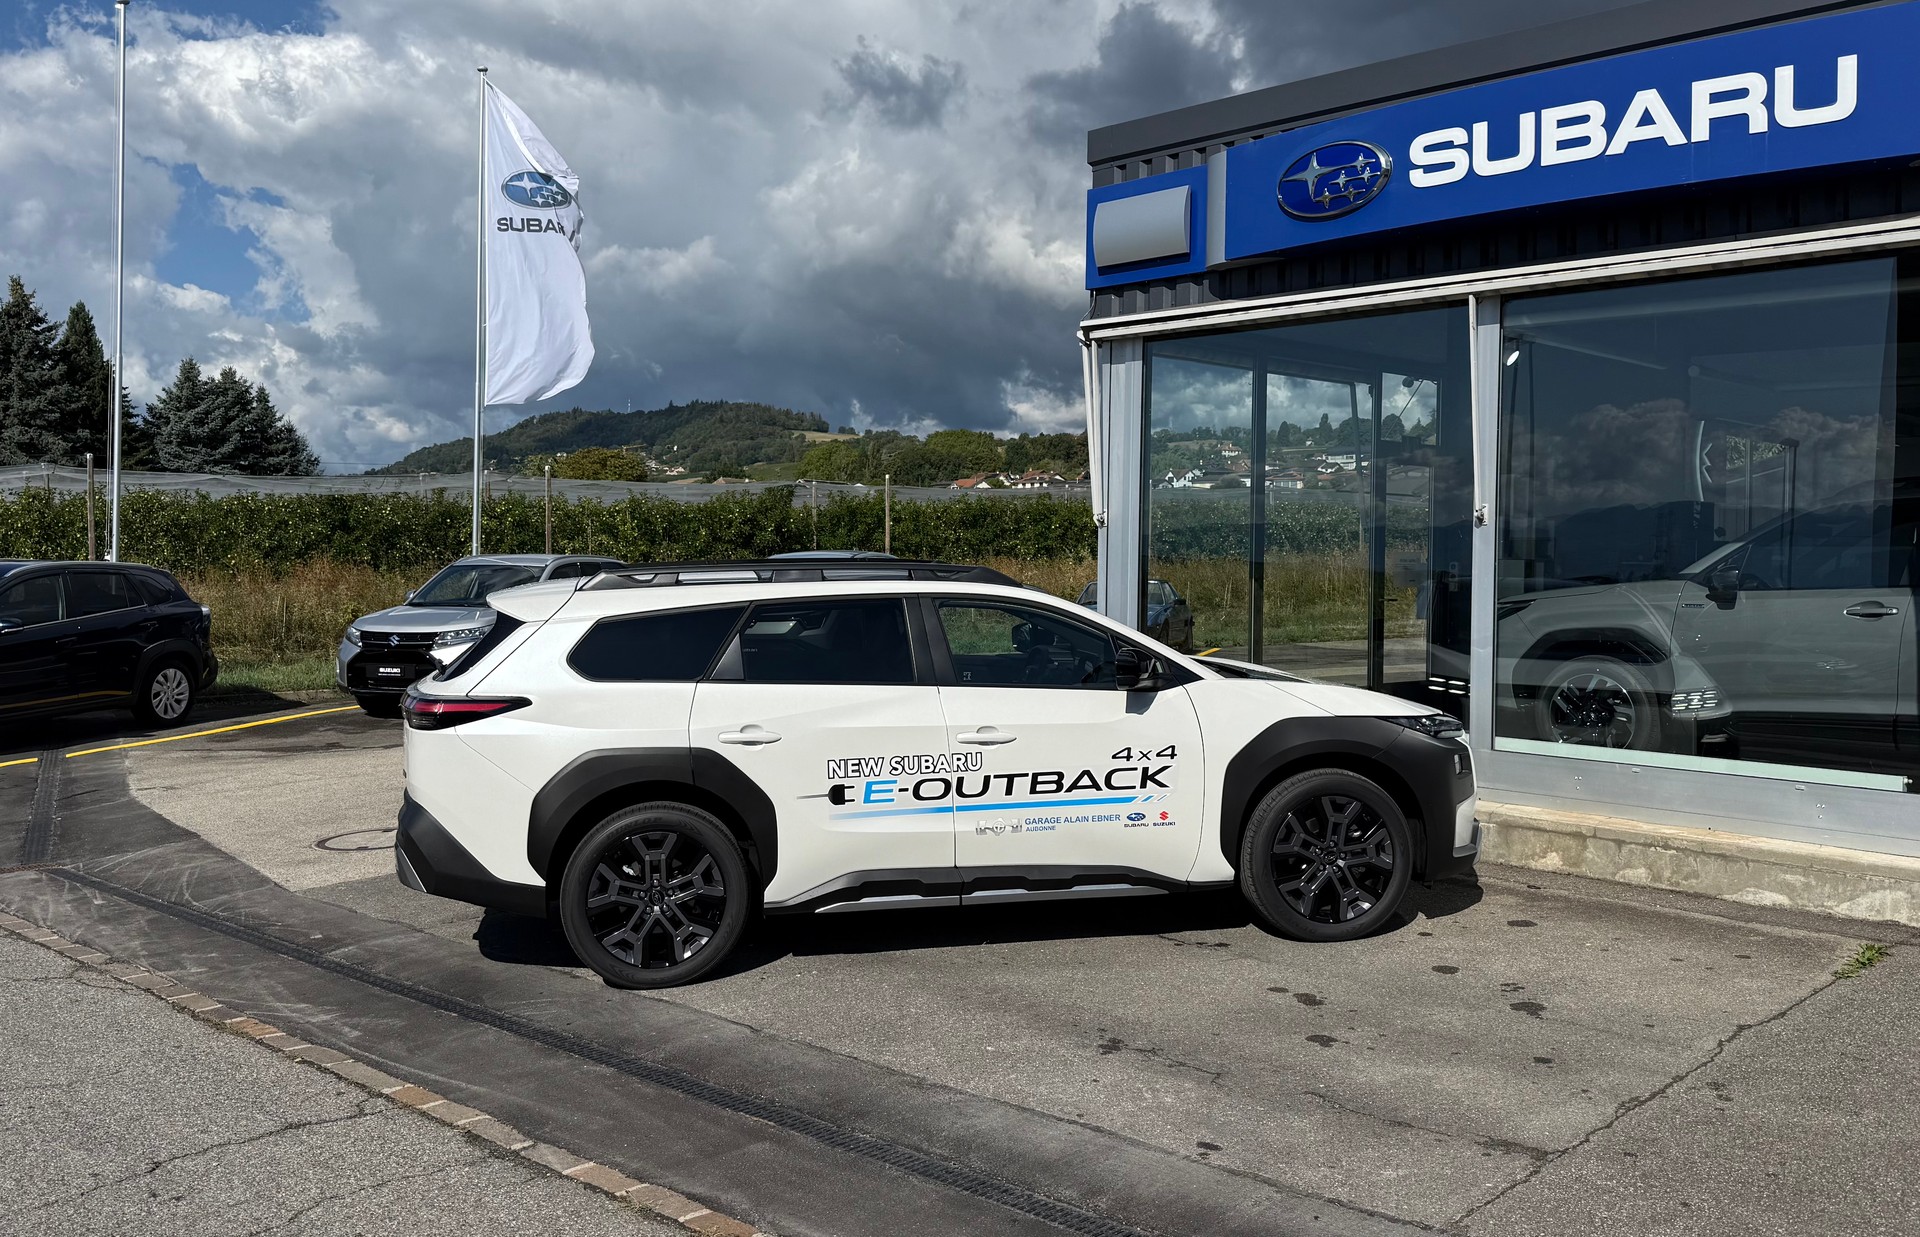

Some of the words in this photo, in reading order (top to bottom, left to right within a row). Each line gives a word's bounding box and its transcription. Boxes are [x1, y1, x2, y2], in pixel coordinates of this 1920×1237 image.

[1409, 54, 1858, 188] SUBARU
[827, 757, 884, 779] NEW
[889, 752, 983, 775] SUBARU
[1111, 745, 1178, 762] 4x4
[863, 765, 1174, 804] E-OUTBACK
[1024, 816, 1061, 825] GARAGE
[1063, 815, 1089, 824] ALAIN
[1091, 814, 1121, 823] EBNER
